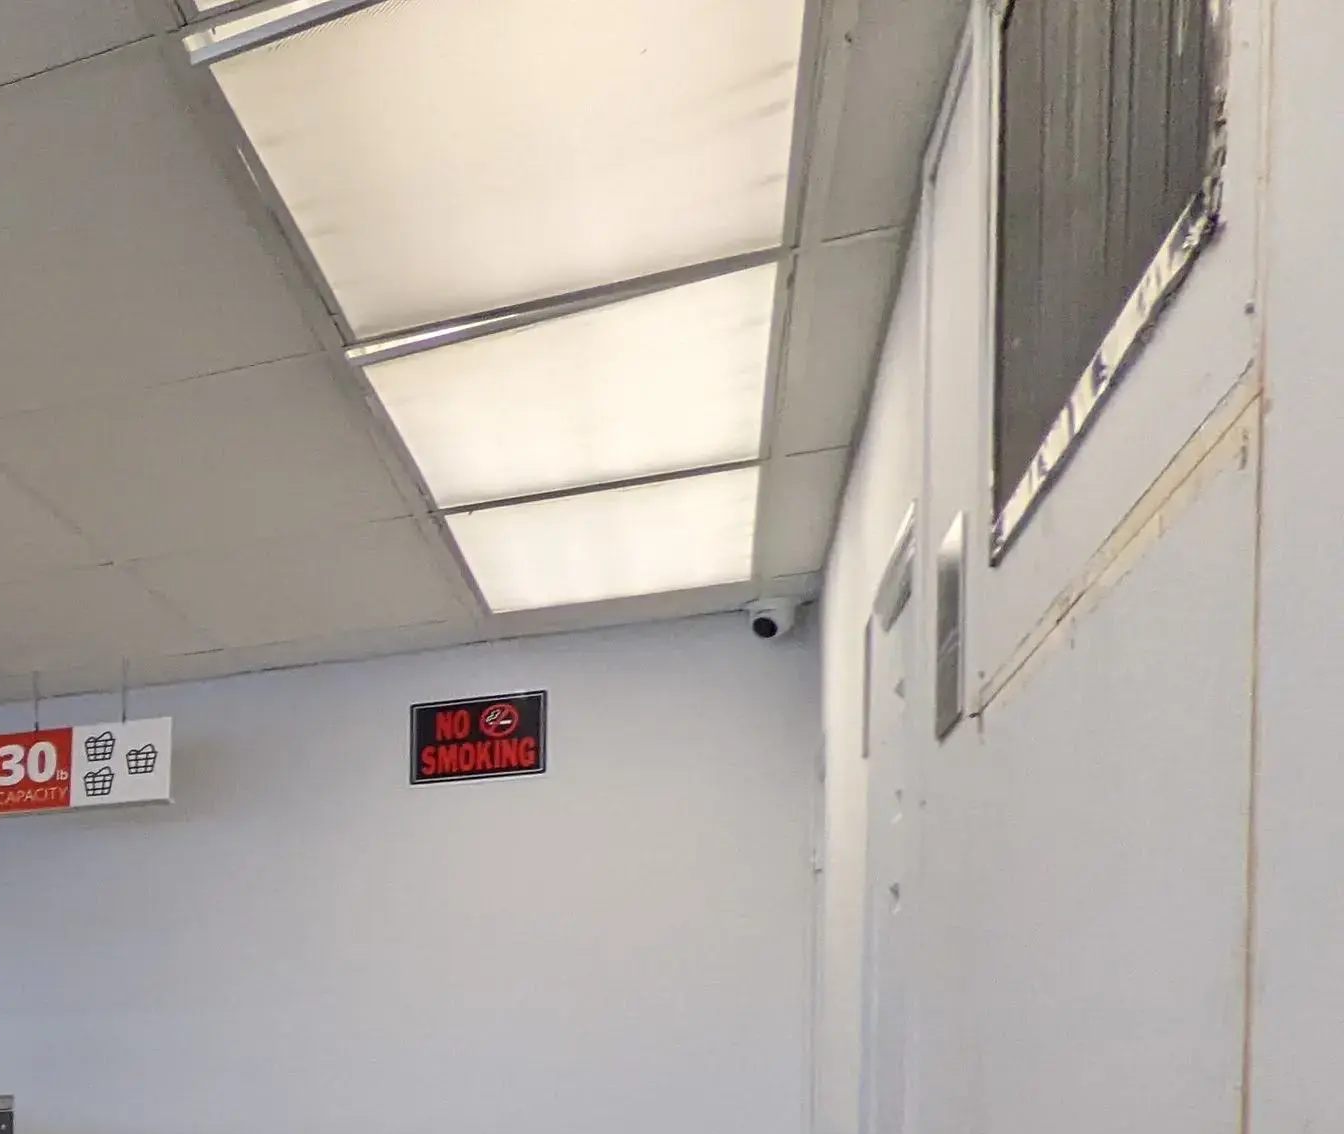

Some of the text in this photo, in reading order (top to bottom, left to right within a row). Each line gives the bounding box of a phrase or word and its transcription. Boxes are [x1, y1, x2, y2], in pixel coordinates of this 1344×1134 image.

[436, 709, 471, 741] NO
[421, 736, 536, 775] SMOKING
[56, 769, 69, 781] lb
